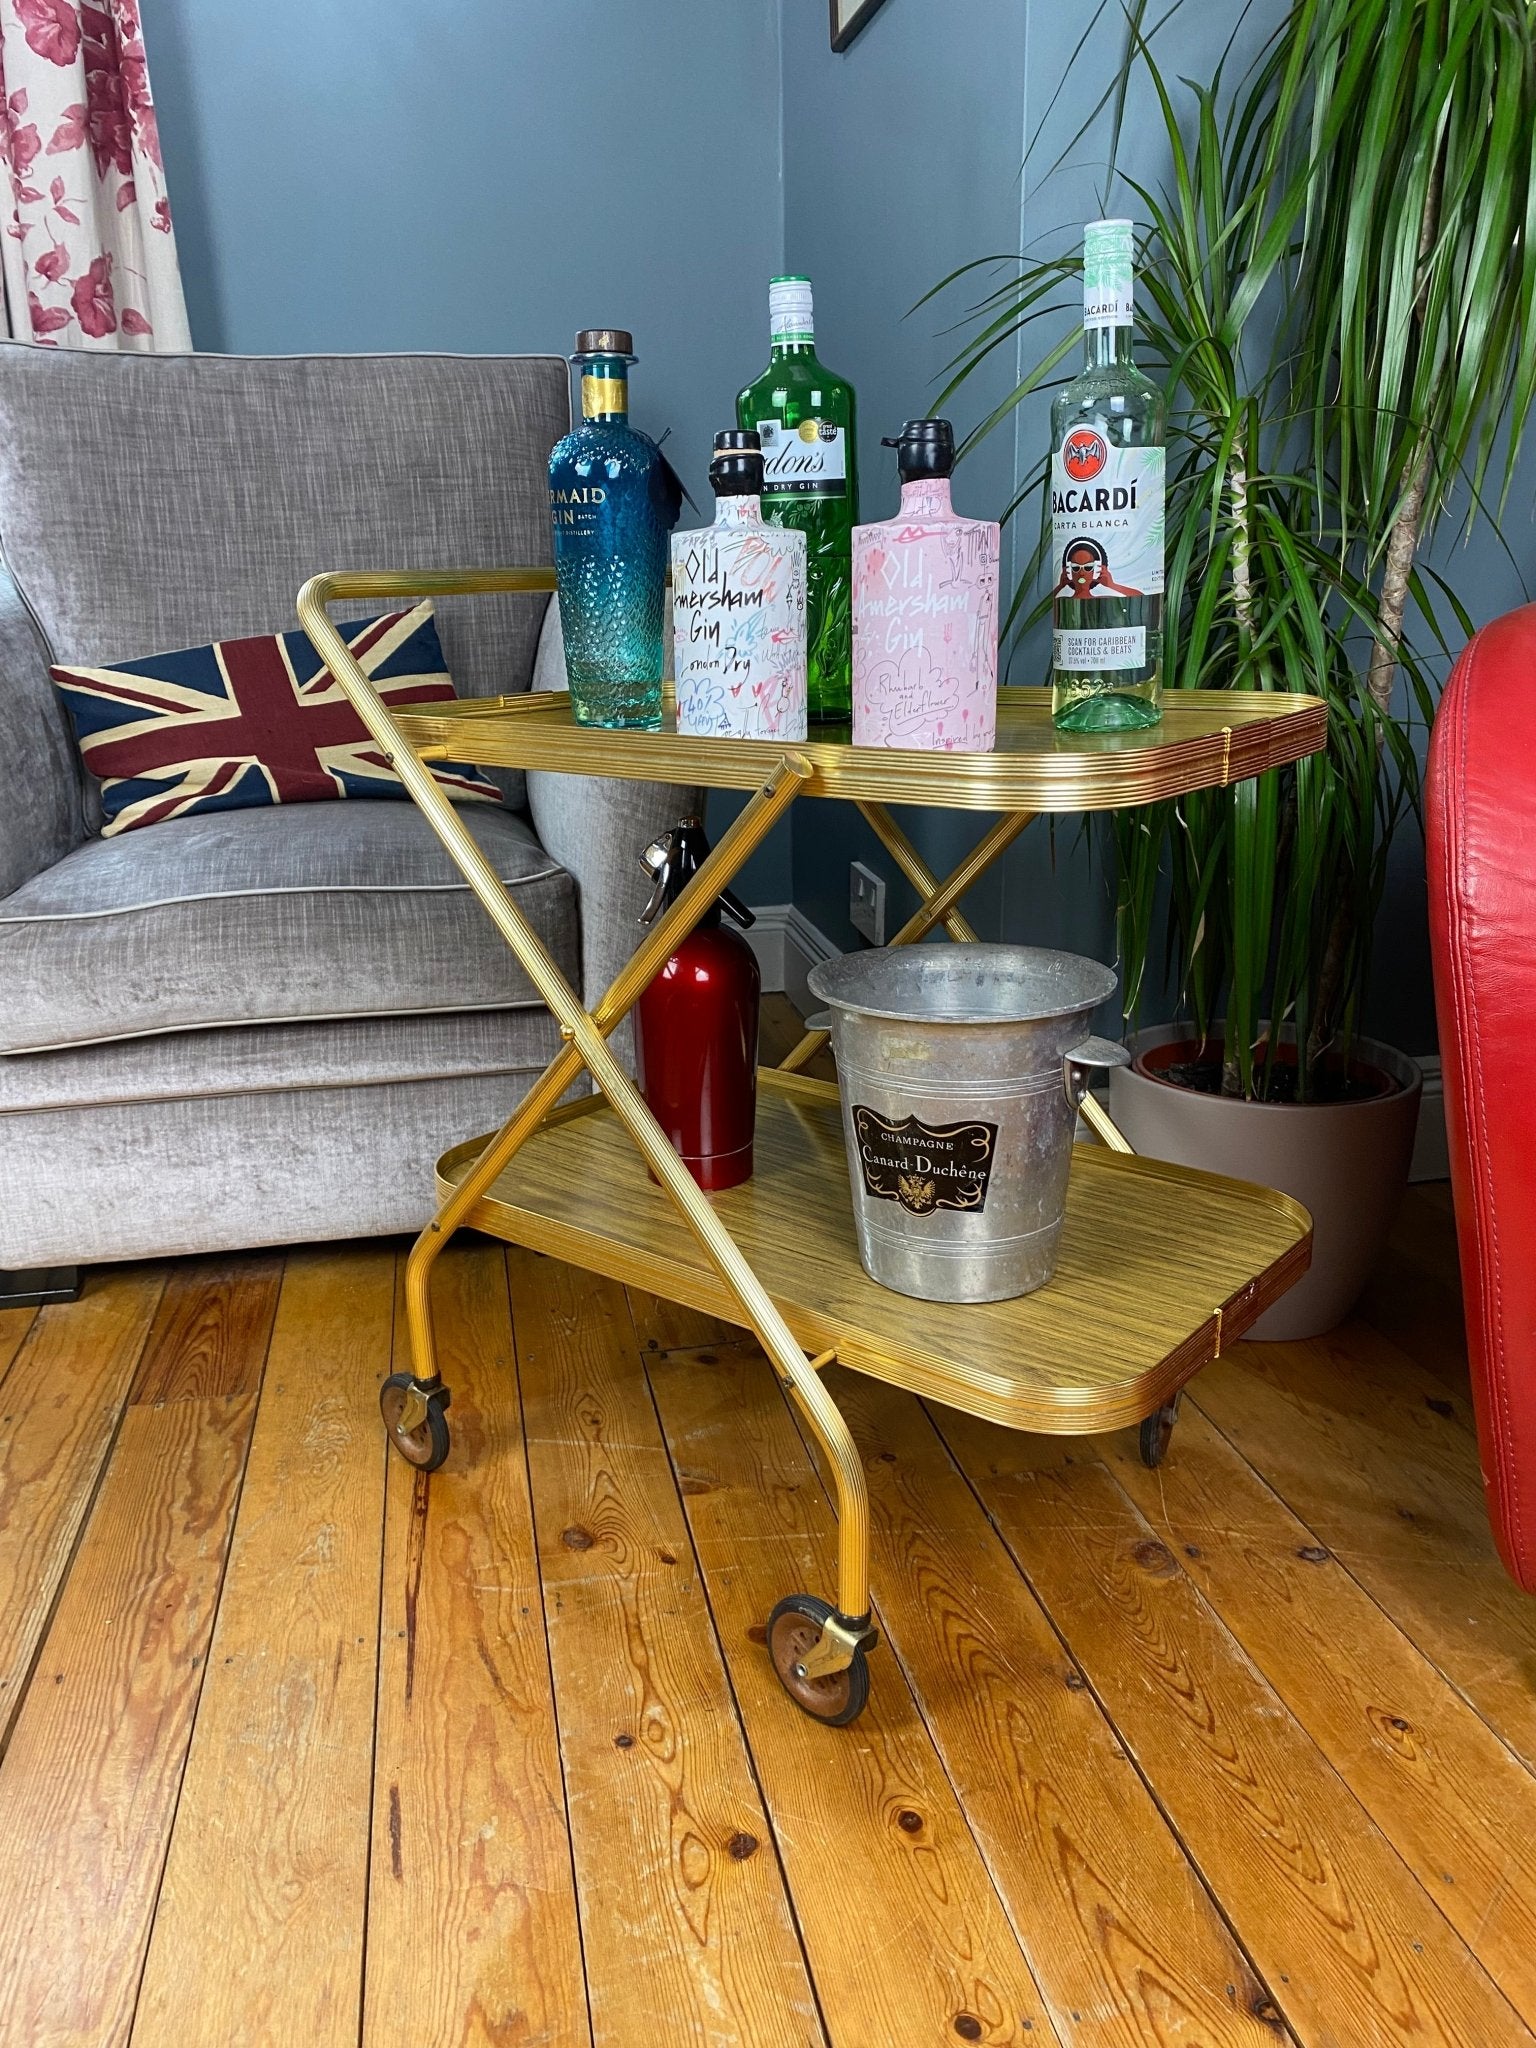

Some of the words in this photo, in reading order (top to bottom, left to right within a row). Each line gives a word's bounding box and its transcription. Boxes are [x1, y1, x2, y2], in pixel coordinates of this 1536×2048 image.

[764, 440, 825, 475] don's
[547, 487, 606, 504] RMAID
[799, 482, 818, 490] GIN
[1052, 478, 1138, 513] BACARDÍ
[551, 509, 574, 525] GIN
[1081, 519, 1129, 529] BLANCA
[685, 547, 718, 584] Old
[880, 548, 923, 590] Old
[859, 573, 970, 618] Amersham
[690, 610, 720, 647] Gin
[886, 616, 923, 657] Gin
[1068, 637, 1082, 646] SCAN
[1084, 637, 1097, 646] FOR
[1098, 635, 1136, 646] CARIBBEAN
[1067, 646, 1101, 655] COCKTAILS
[1103, 647, 1108, 655] &
[1111, 645, 1132, 655] BEATS
[723, 646, 751, 690] Dry
[881, 1132, 954, 1151] CHAMPAGNE
